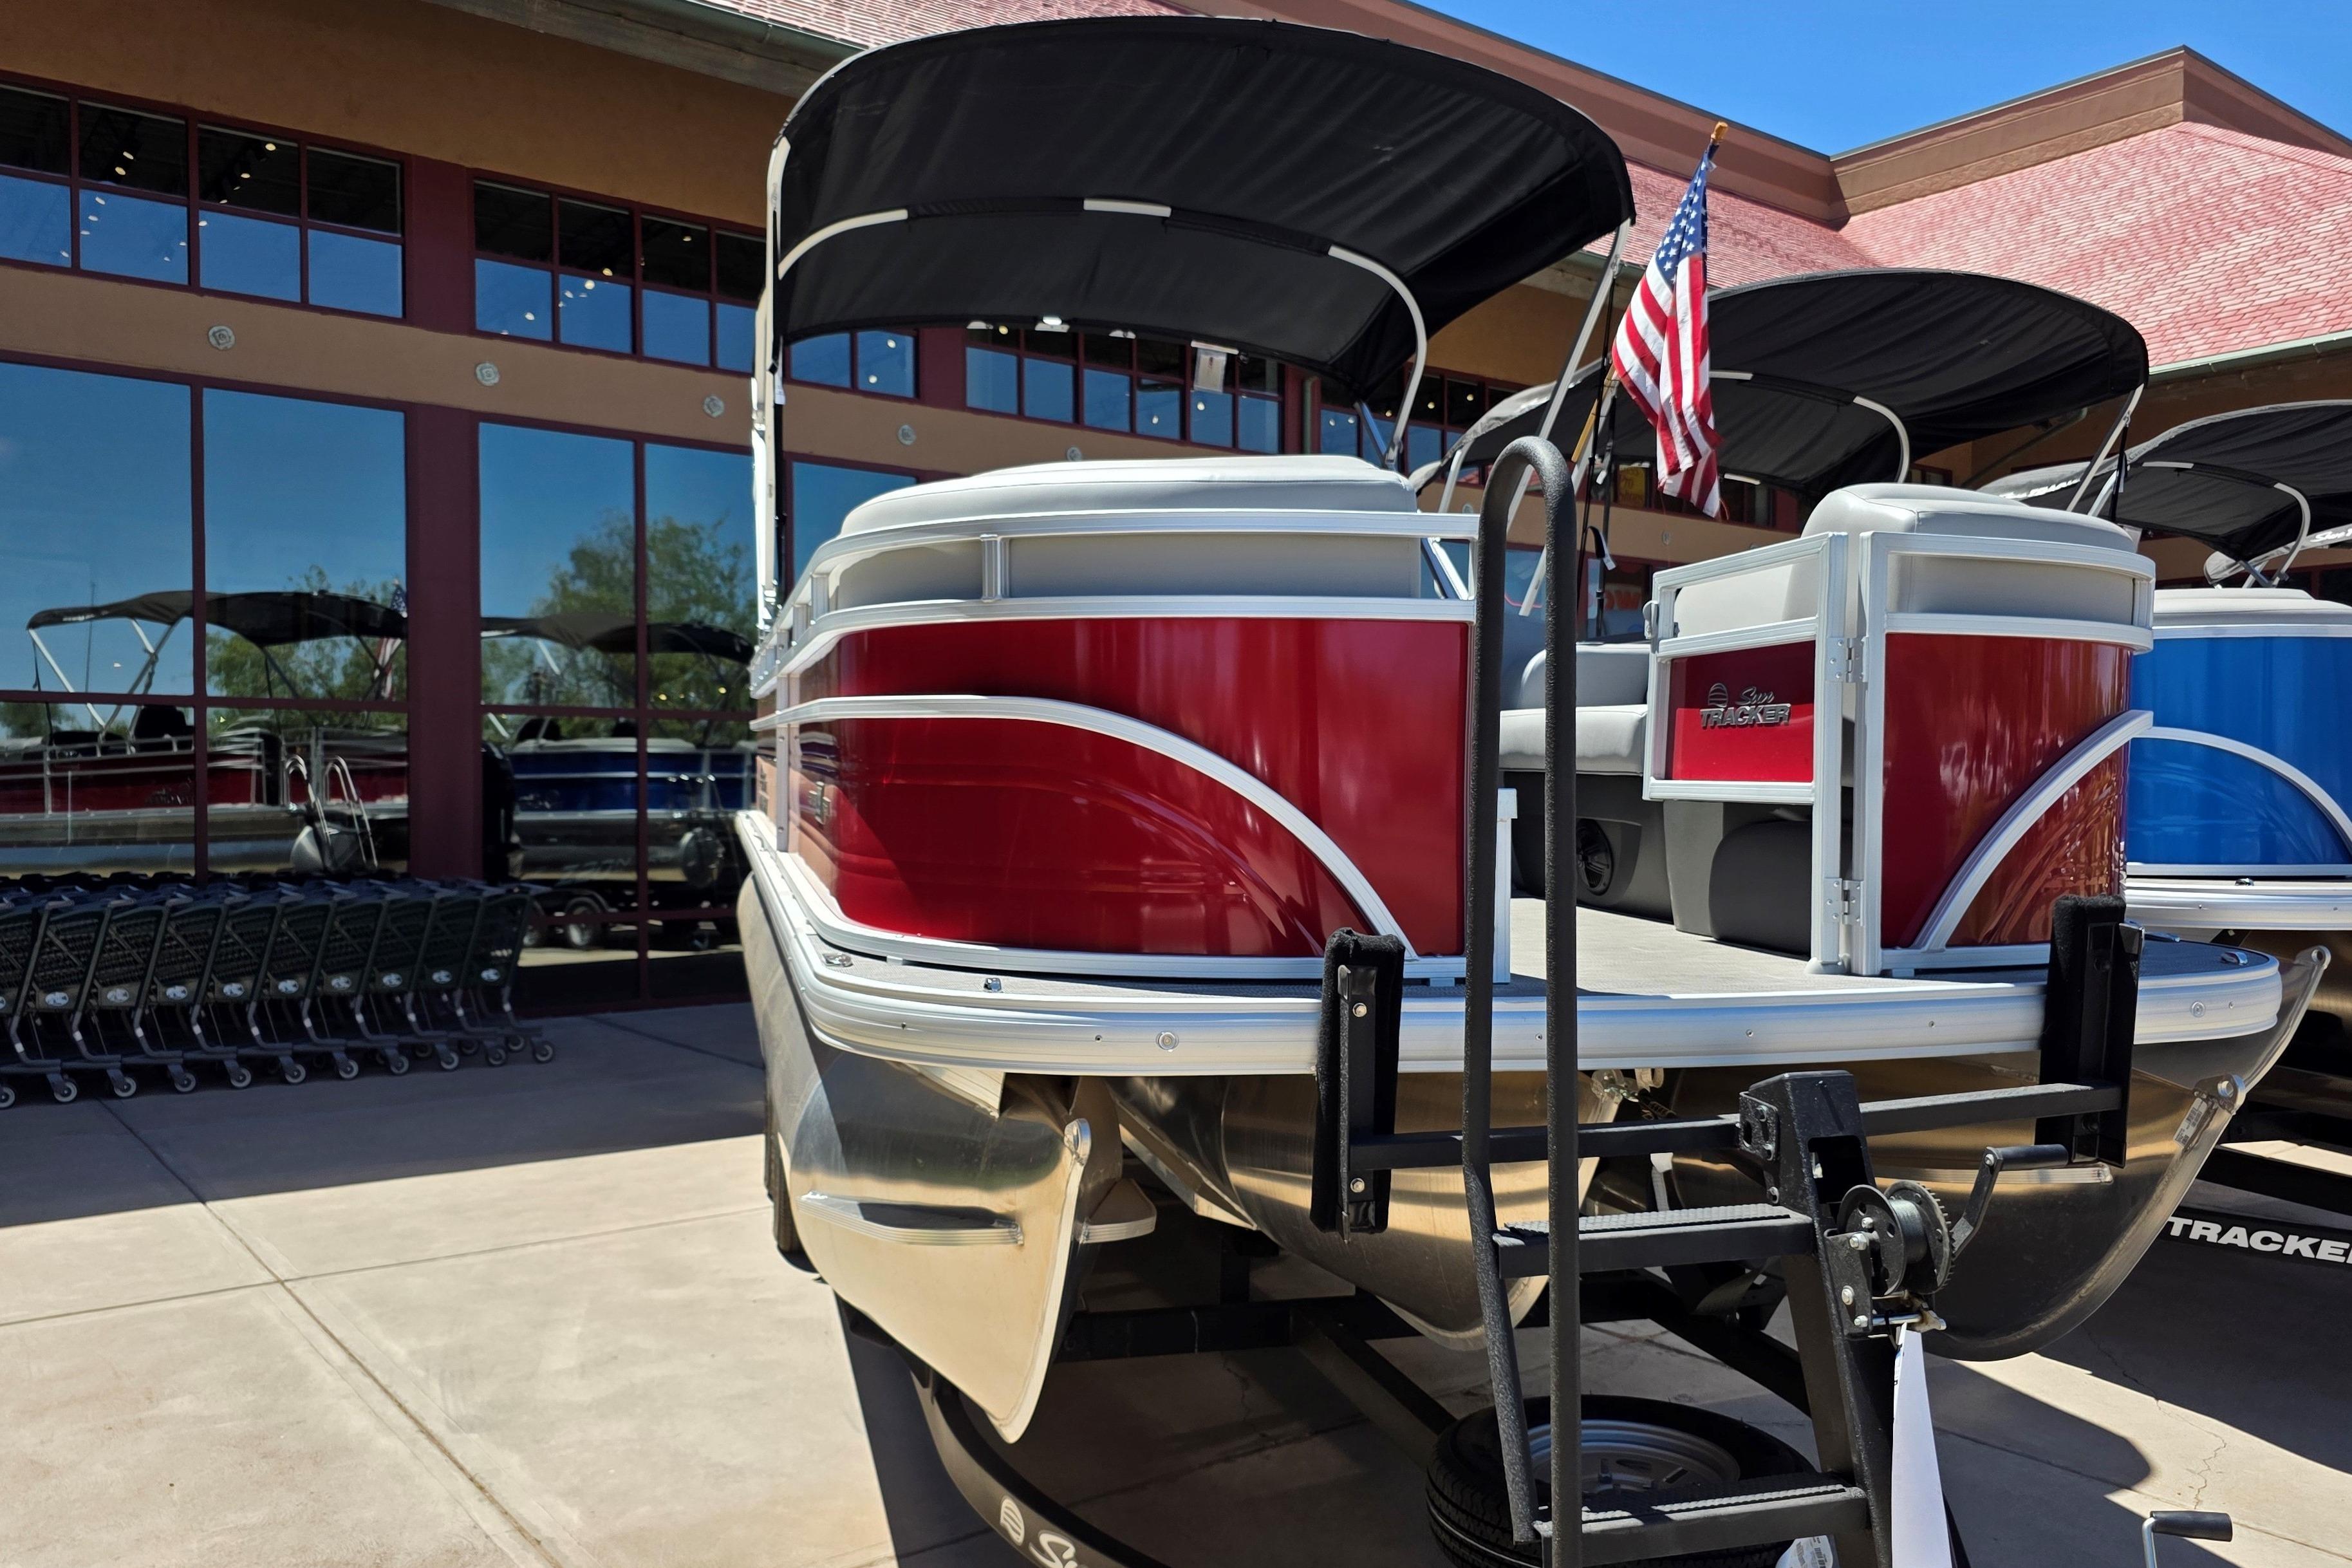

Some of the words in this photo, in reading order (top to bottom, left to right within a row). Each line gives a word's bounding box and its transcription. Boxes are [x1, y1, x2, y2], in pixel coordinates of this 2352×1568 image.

[1735, 686, 1775, 705] Sun
[1700, 703, 1791, 727] TRACKER
[2167, 1216, 2352, 1264] TRACKE
